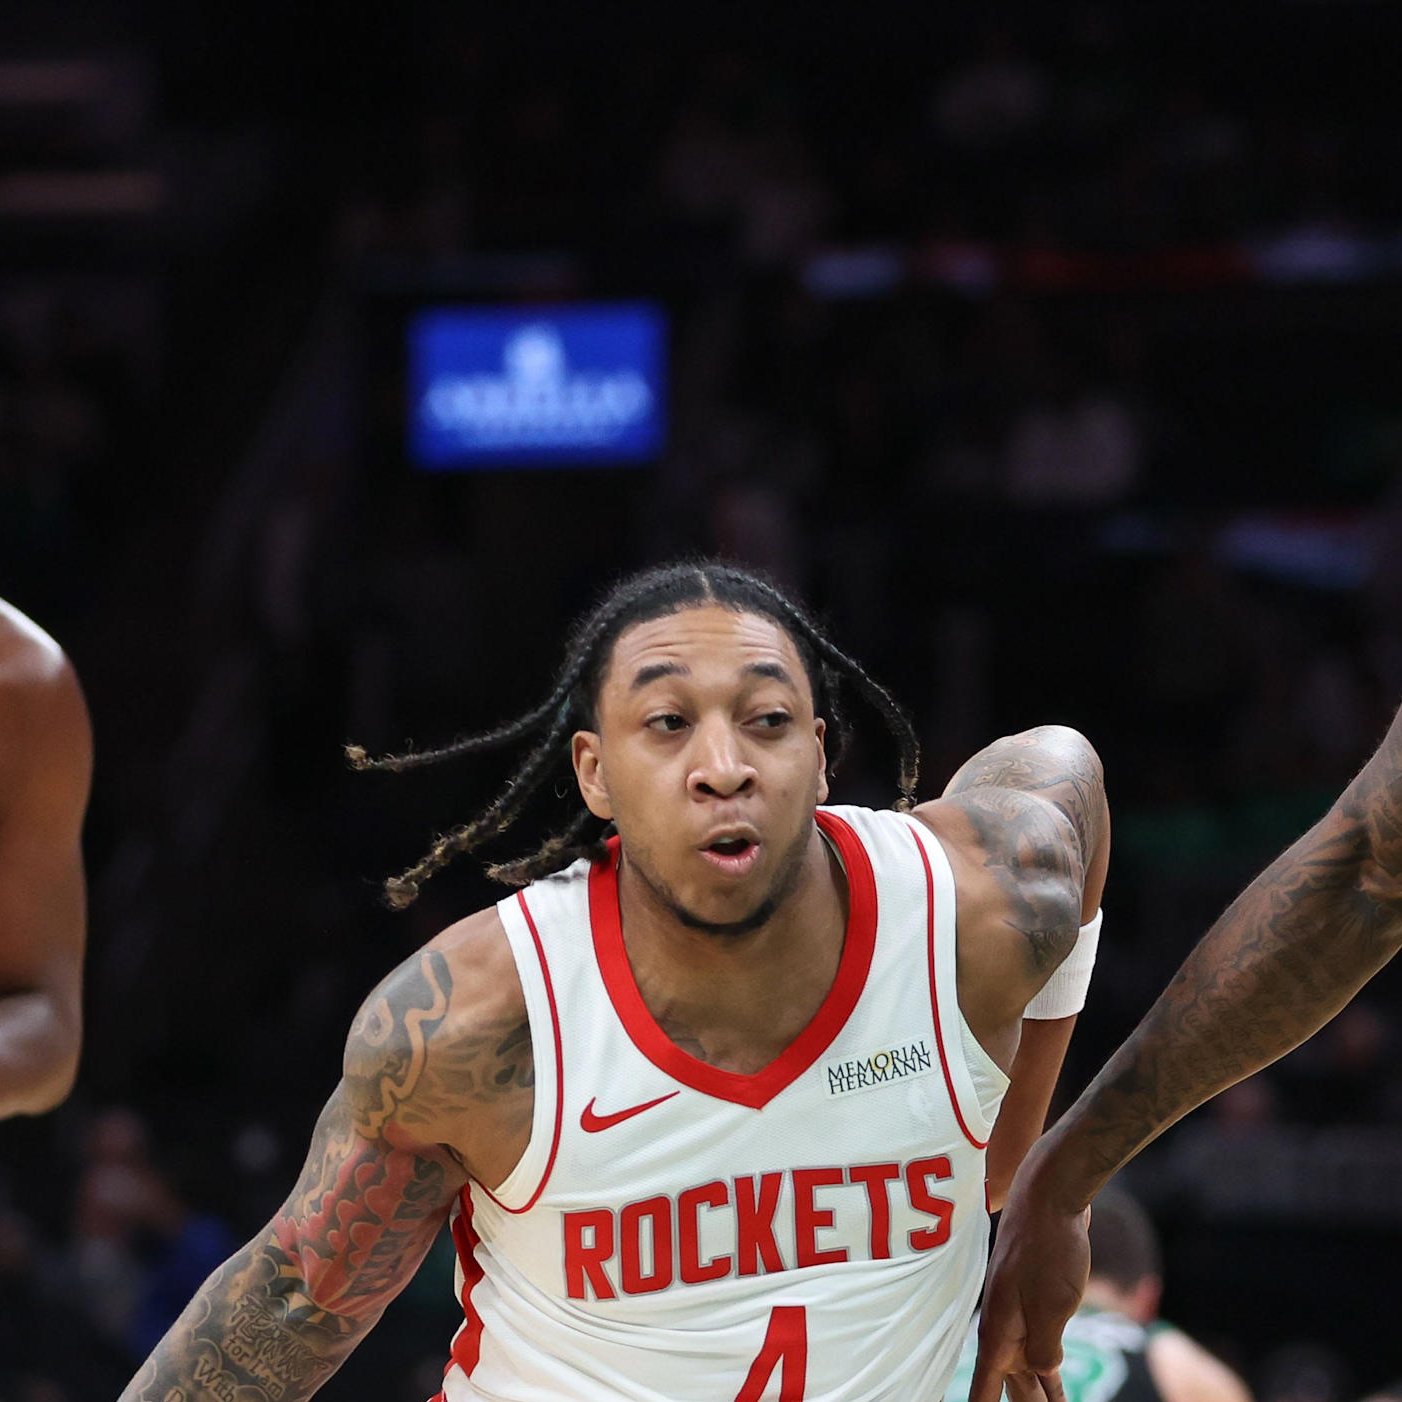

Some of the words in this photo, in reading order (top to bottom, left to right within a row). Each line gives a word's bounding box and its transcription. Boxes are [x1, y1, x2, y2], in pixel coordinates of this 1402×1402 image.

[827, 1040, 931, 1082] MEMORIAL
[829, 1052, 932, 1095] HERMANN
[561, 1154, 954, 1301] ROCKETS
[223, 1337, 251, 1361] for
[260, 1376, 285, 1398] am
